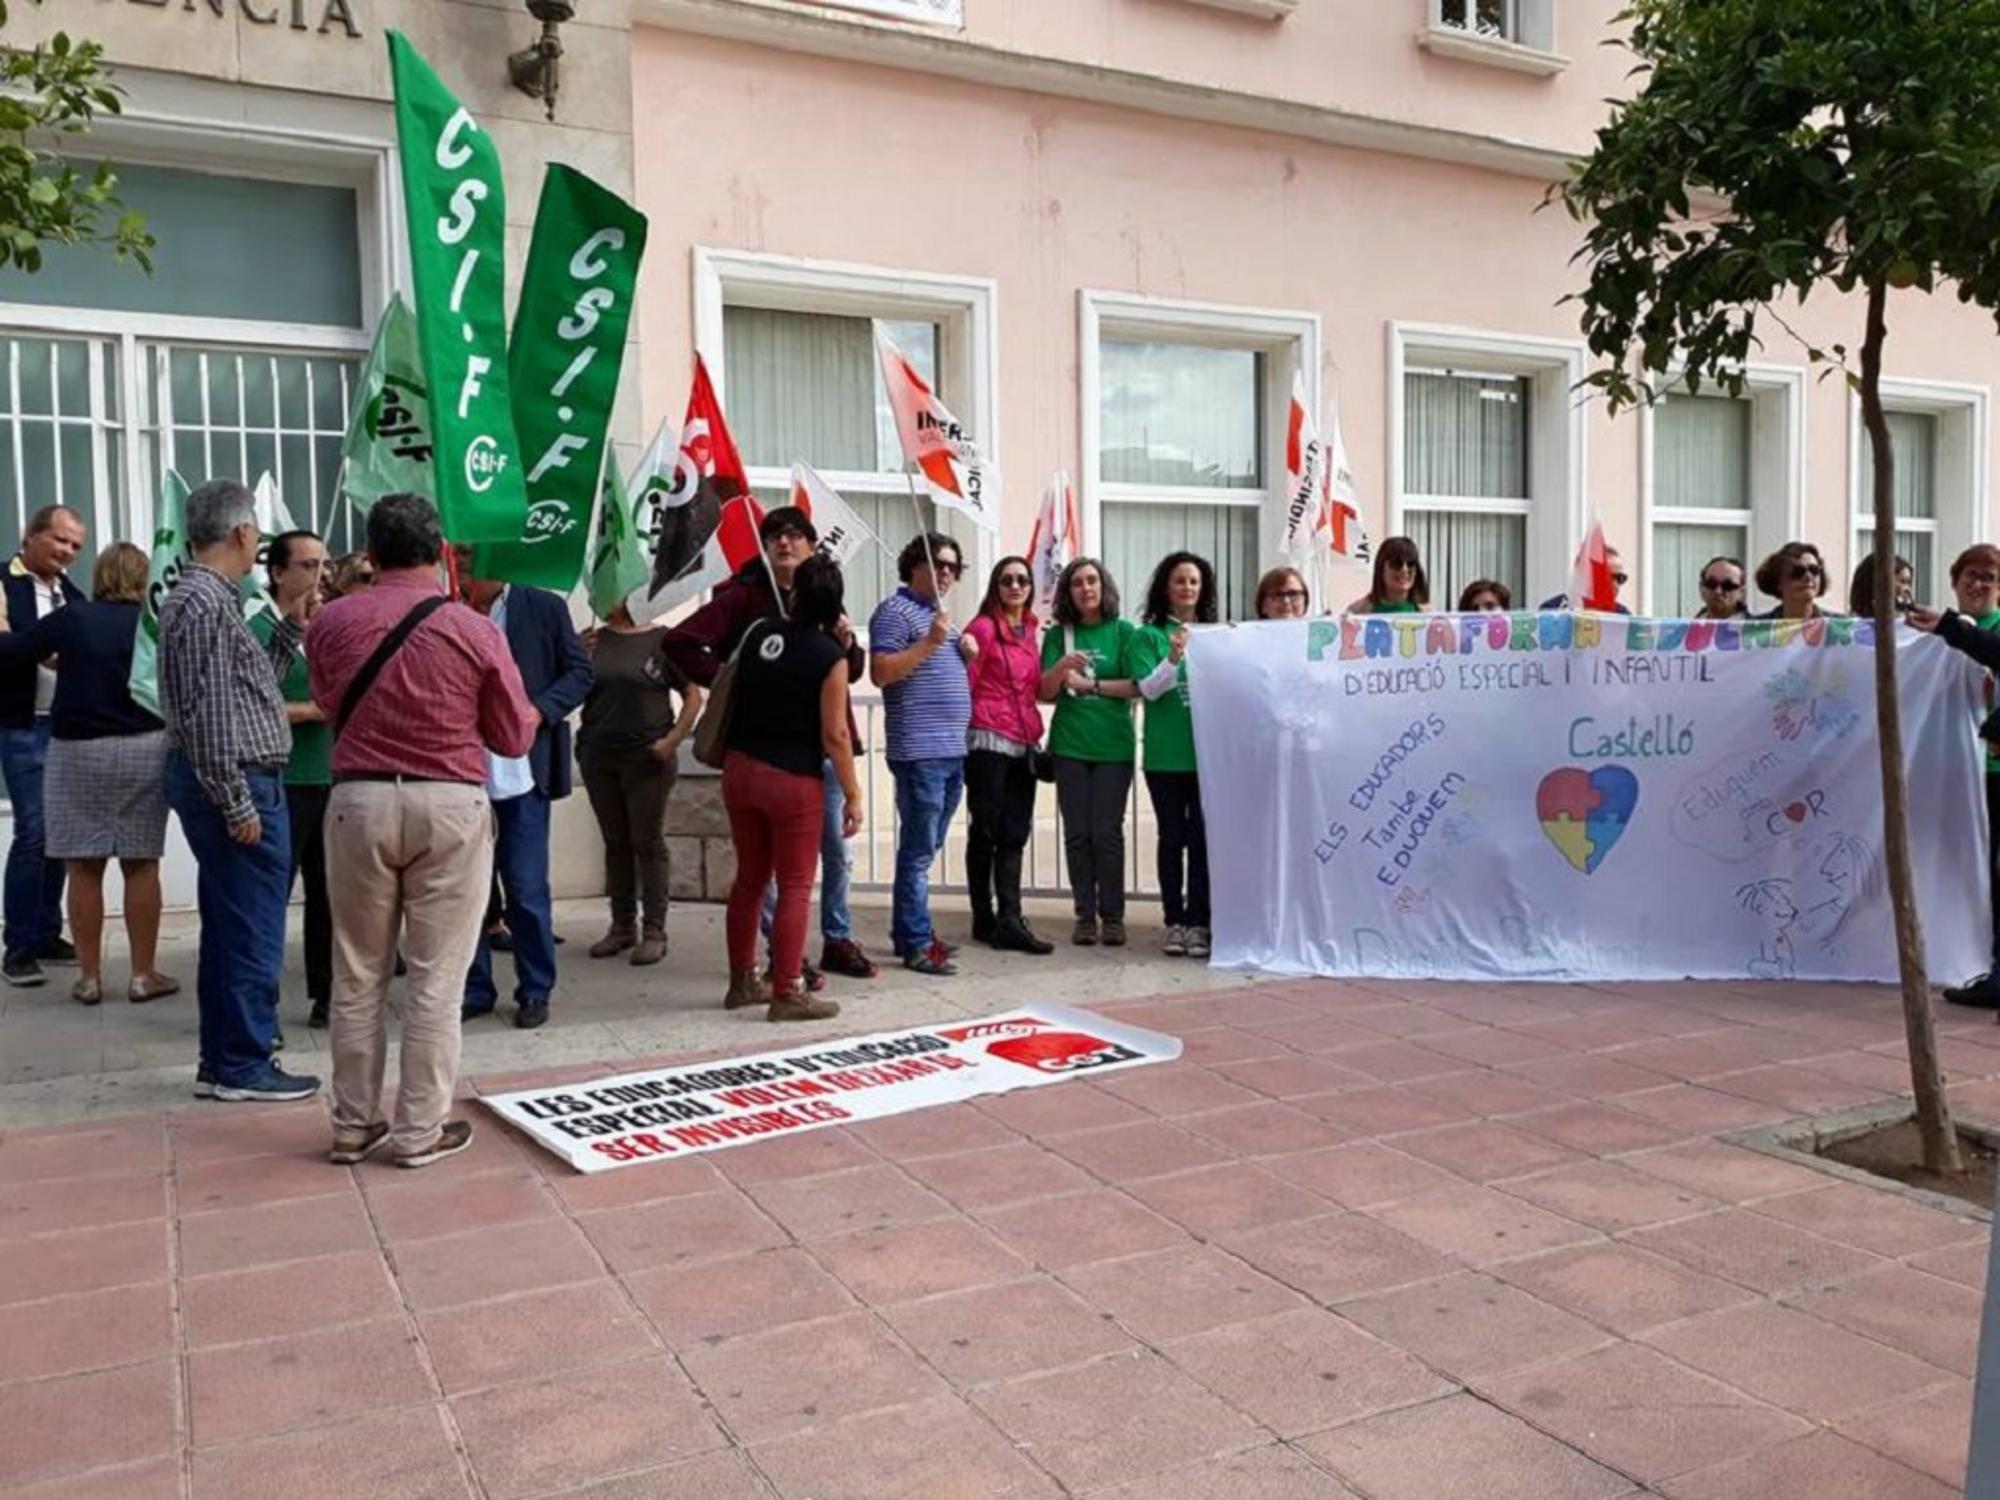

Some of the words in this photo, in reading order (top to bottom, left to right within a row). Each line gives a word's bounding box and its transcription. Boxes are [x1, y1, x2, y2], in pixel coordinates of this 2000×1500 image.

[1307, 612, 1602, 662] PLATAFORMA
[1592, 653, 1715, 685] INFANTIL
[1568, 712, 1696, 759] Castelló
[1313, 821, 1349, 866] ELS
[1376, 771, 1467, 887] EDUQUEM
[515, 1092, 594, 1120] LES
[583, 1061, 794, 1107] EDUCADORES
[551, 1097, 724, 1139] ESPECIAL
[709, 1076, 838, 1109] VOLEM
[817, 1058, 942, 1092] DEIXAR
[590, 1133, 679, 1162] SER
[663, 1100, 853, 1148] INVISIBLES
